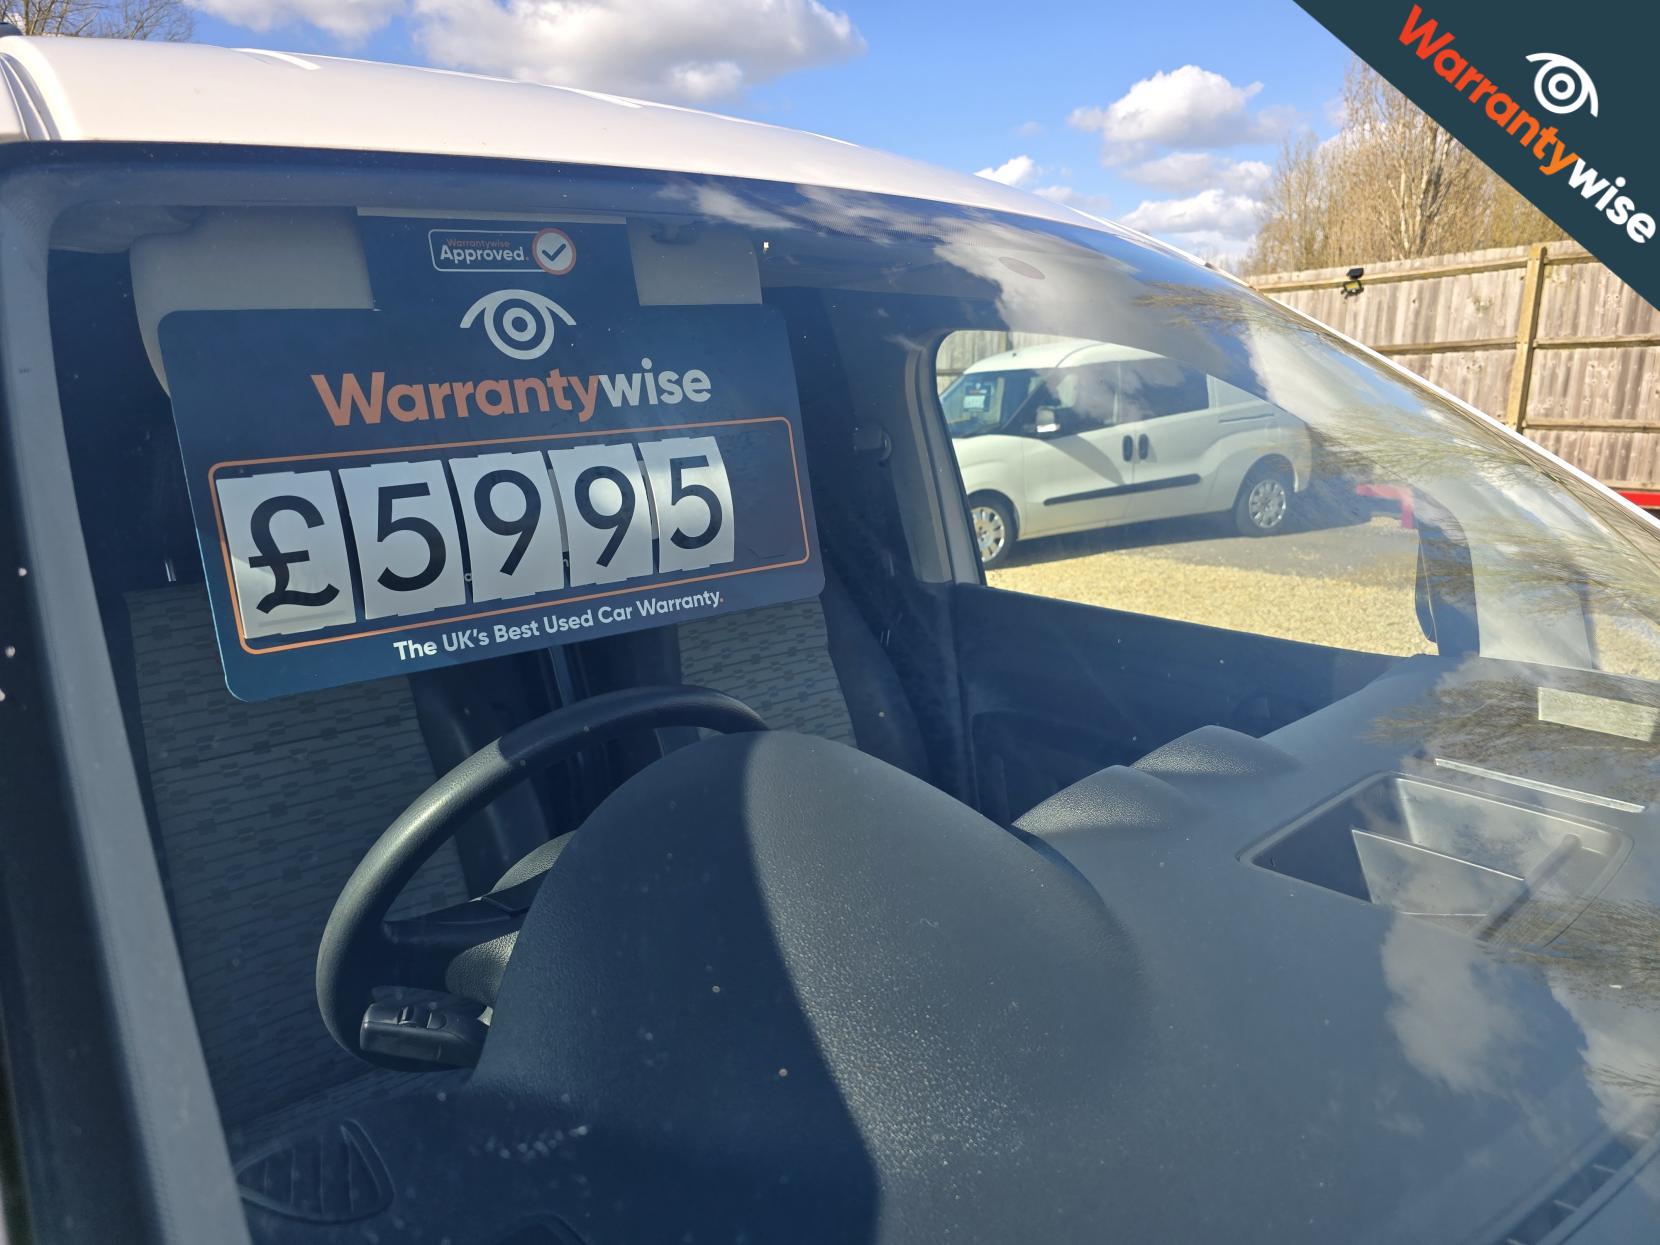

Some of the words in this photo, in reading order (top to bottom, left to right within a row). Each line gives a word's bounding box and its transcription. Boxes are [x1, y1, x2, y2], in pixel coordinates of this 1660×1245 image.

[440, 245, 530, 264] Approved.
[310, 357, 712, 427] Warrantywise
[249, 454, 724, 614] £5995
[393, 638, 438, 661] The
[442, 628, 490, 652] UK's
[493, 619, 540, 643] Best
[543, 610, 594, 633] Used
[597, 605, 633, 624] Car
[635, 588, 725, 616] Warranty.
